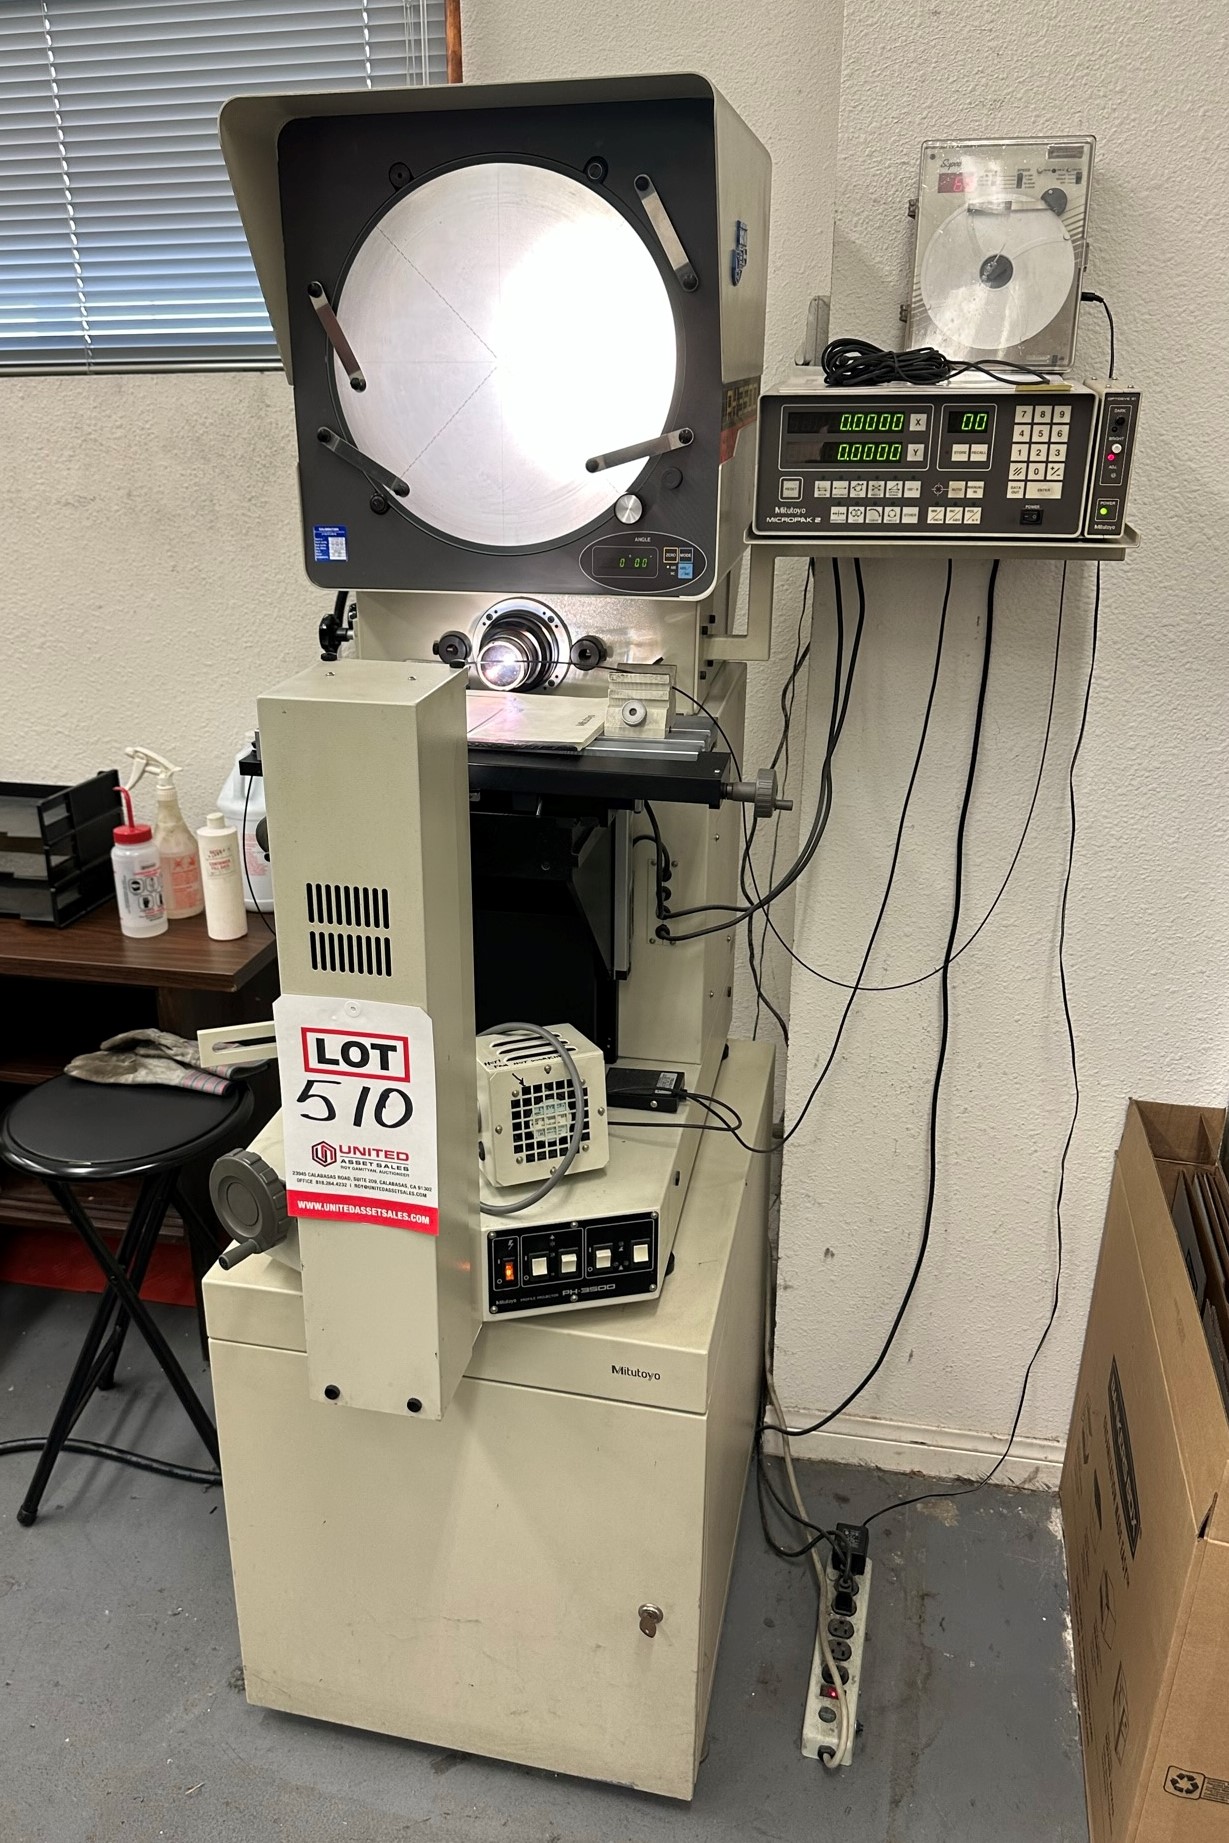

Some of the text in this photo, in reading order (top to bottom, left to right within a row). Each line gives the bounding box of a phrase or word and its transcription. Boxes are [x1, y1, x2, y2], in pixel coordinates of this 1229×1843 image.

[1021, 410, 1027, 419] 7
[1039, 410, 1046, 419] 8
[1059, 410, 1066, 419] 9
[840, 413, 905, 431] 0.0000
[915, 418, 922, 427] X
[961, 413, 988, 431] 00
[1018, 429, 1025, 438] 4
[1037, 429, 1044, 438] 5
[1056, 429, 1063, 438] 6
[837, 444, 902, 461] 0.0000
[912, 448, 920, 457] Y
[1035, 448, 1042, 457] 2
[1054, 448, 1061, 457] 3
[1033, 467, 1039, 475] 0
[774, 506, 806, 516] Mitutoyo
[316, 1038, 398, 1071] LOT
[296, 1080, 413, 1129] 510
[339, 1144, 410, 1162] UNITED
[340, 1158, 410, 1172] ASSET SALES
[308, 1172, 336, 1180] CALABASAS
[297, 1200, 430, 1225] WWW.UNITEDASSETSALES.COM
[611, 1364, 661, 1381] Mitutoyo
